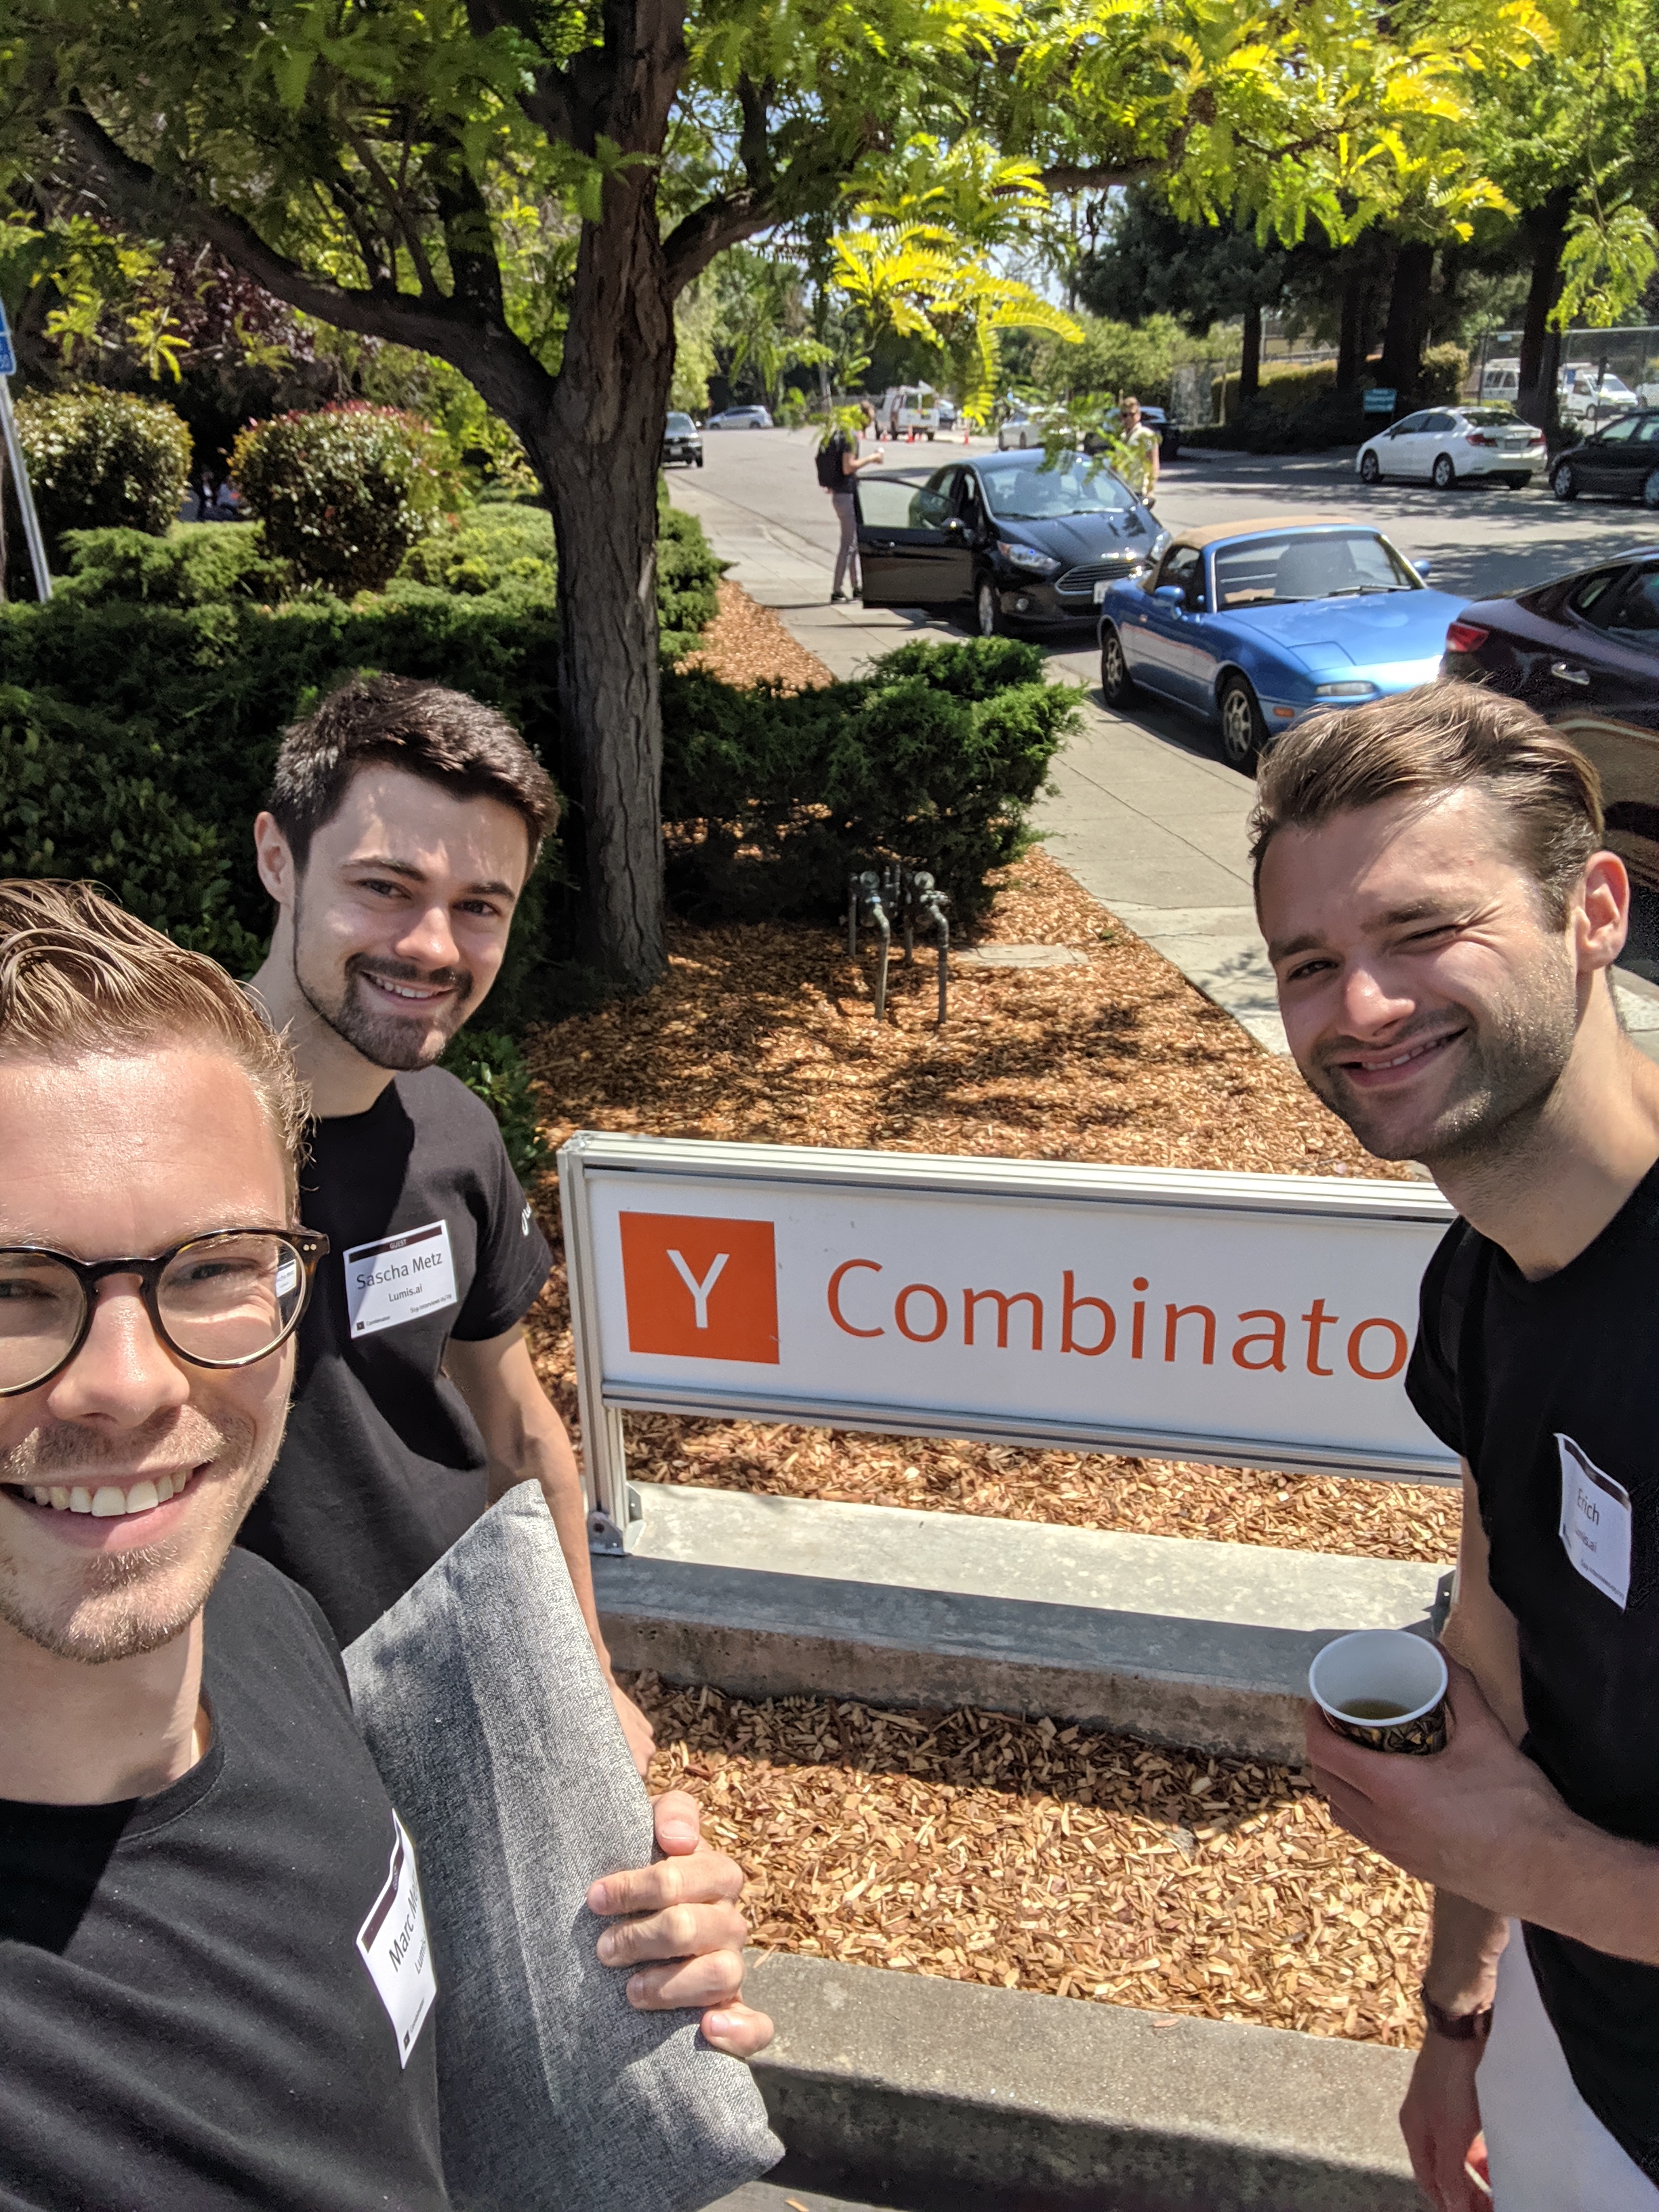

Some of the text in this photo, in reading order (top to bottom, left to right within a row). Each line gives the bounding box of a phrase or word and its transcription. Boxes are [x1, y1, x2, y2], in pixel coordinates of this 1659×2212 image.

[390, 1239, 407, 1249] GUEST
[356, 1252, 443, 1290] Sascha Metz
[388, 1283, 422, 1302] Lumis.ai
[666, 1250, 1408, 1380] Y Combinato
[1577, 1488, 1600, 1525] Erich
[389, 1913, 415, 1973] Marc
